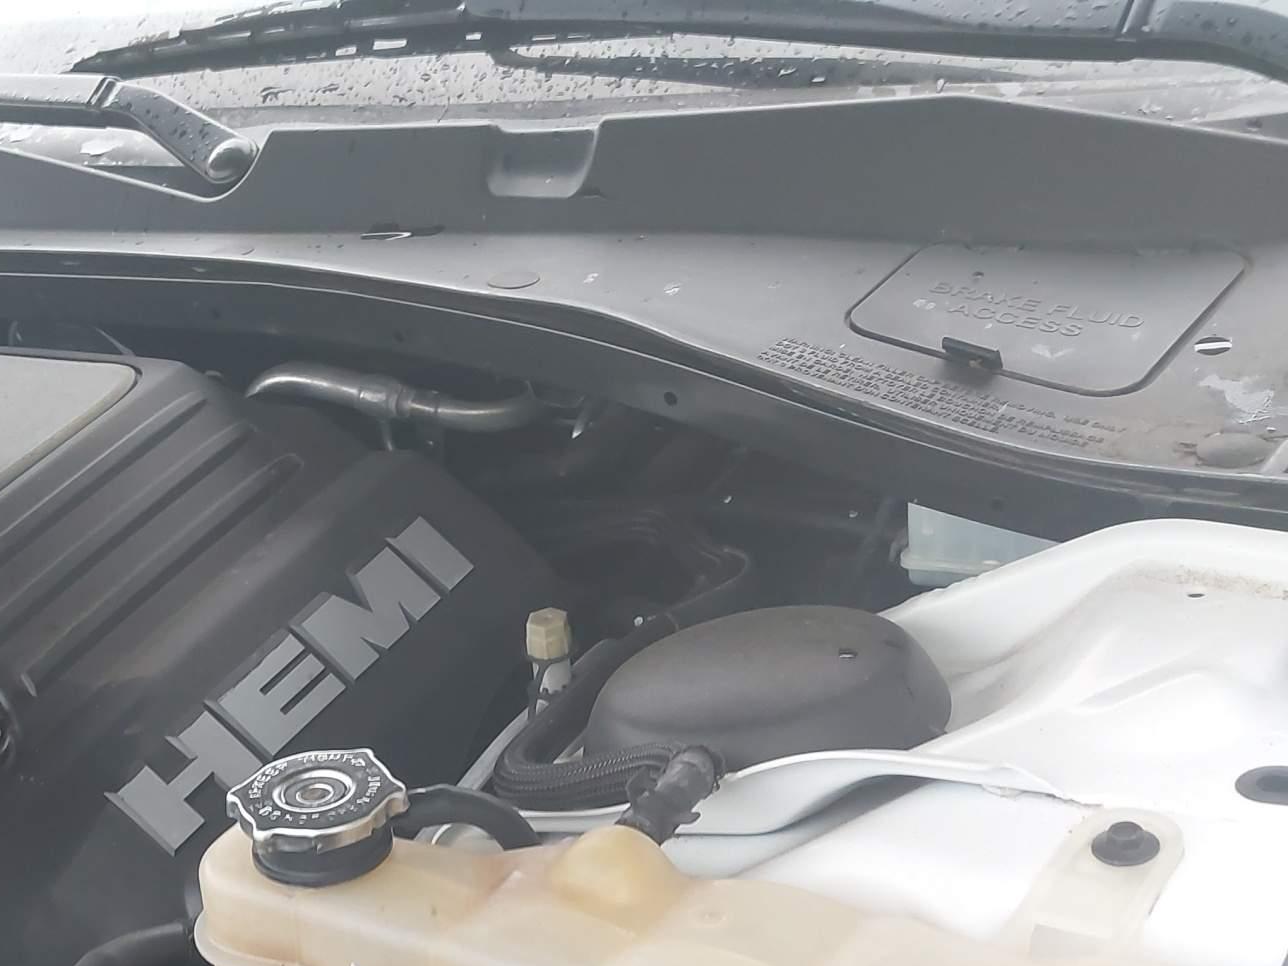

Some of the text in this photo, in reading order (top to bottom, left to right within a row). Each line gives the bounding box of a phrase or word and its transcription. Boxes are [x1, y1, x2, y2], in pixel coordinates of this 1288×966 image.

[928, 281, 1145, 328] BRAKE FLUID
[947, 304, 1083, 337] ACCESS
[105, 516, 475, 857] HEMI
